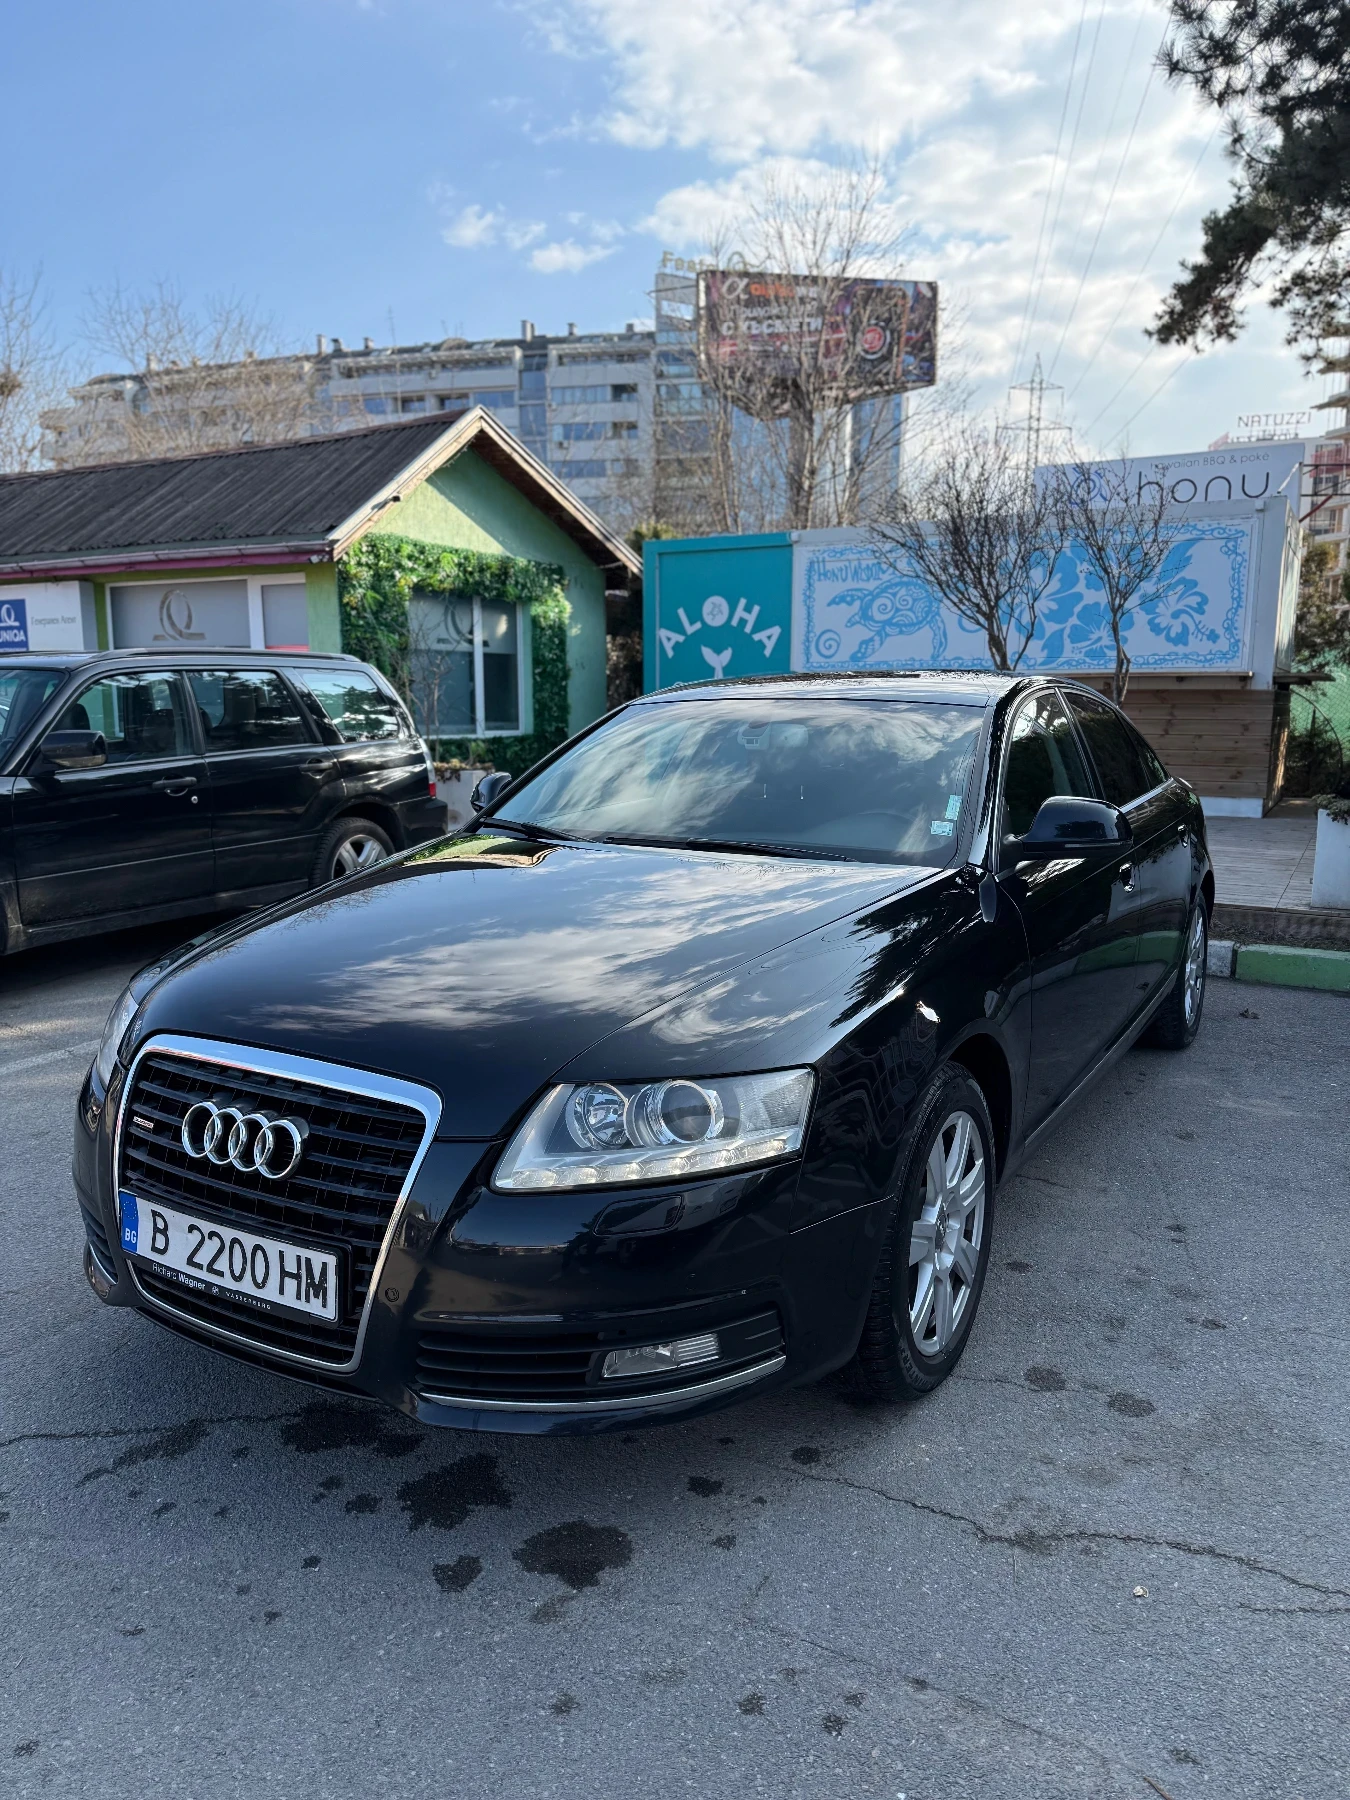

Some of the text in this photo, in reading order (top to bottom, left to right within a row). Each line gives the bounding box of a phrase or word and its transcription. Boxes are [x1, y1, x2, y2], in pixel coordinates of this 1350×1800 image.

[1236, 411, 1312, 428] NATUZZI
[1150, 458, 1200, 470] hawaiian
[1203, 456, 1225, 466] BBQ
[1229, 455, 1237, 464] &
[1137, 471, 1270, 506] honu
[659, 595, 782, 659] ALOHA
[124, 1228, 137, 1244] BG
[151, 1209, 328, 1308] B 2200 HM
[178, 1273, 206, 1291] Wagner
